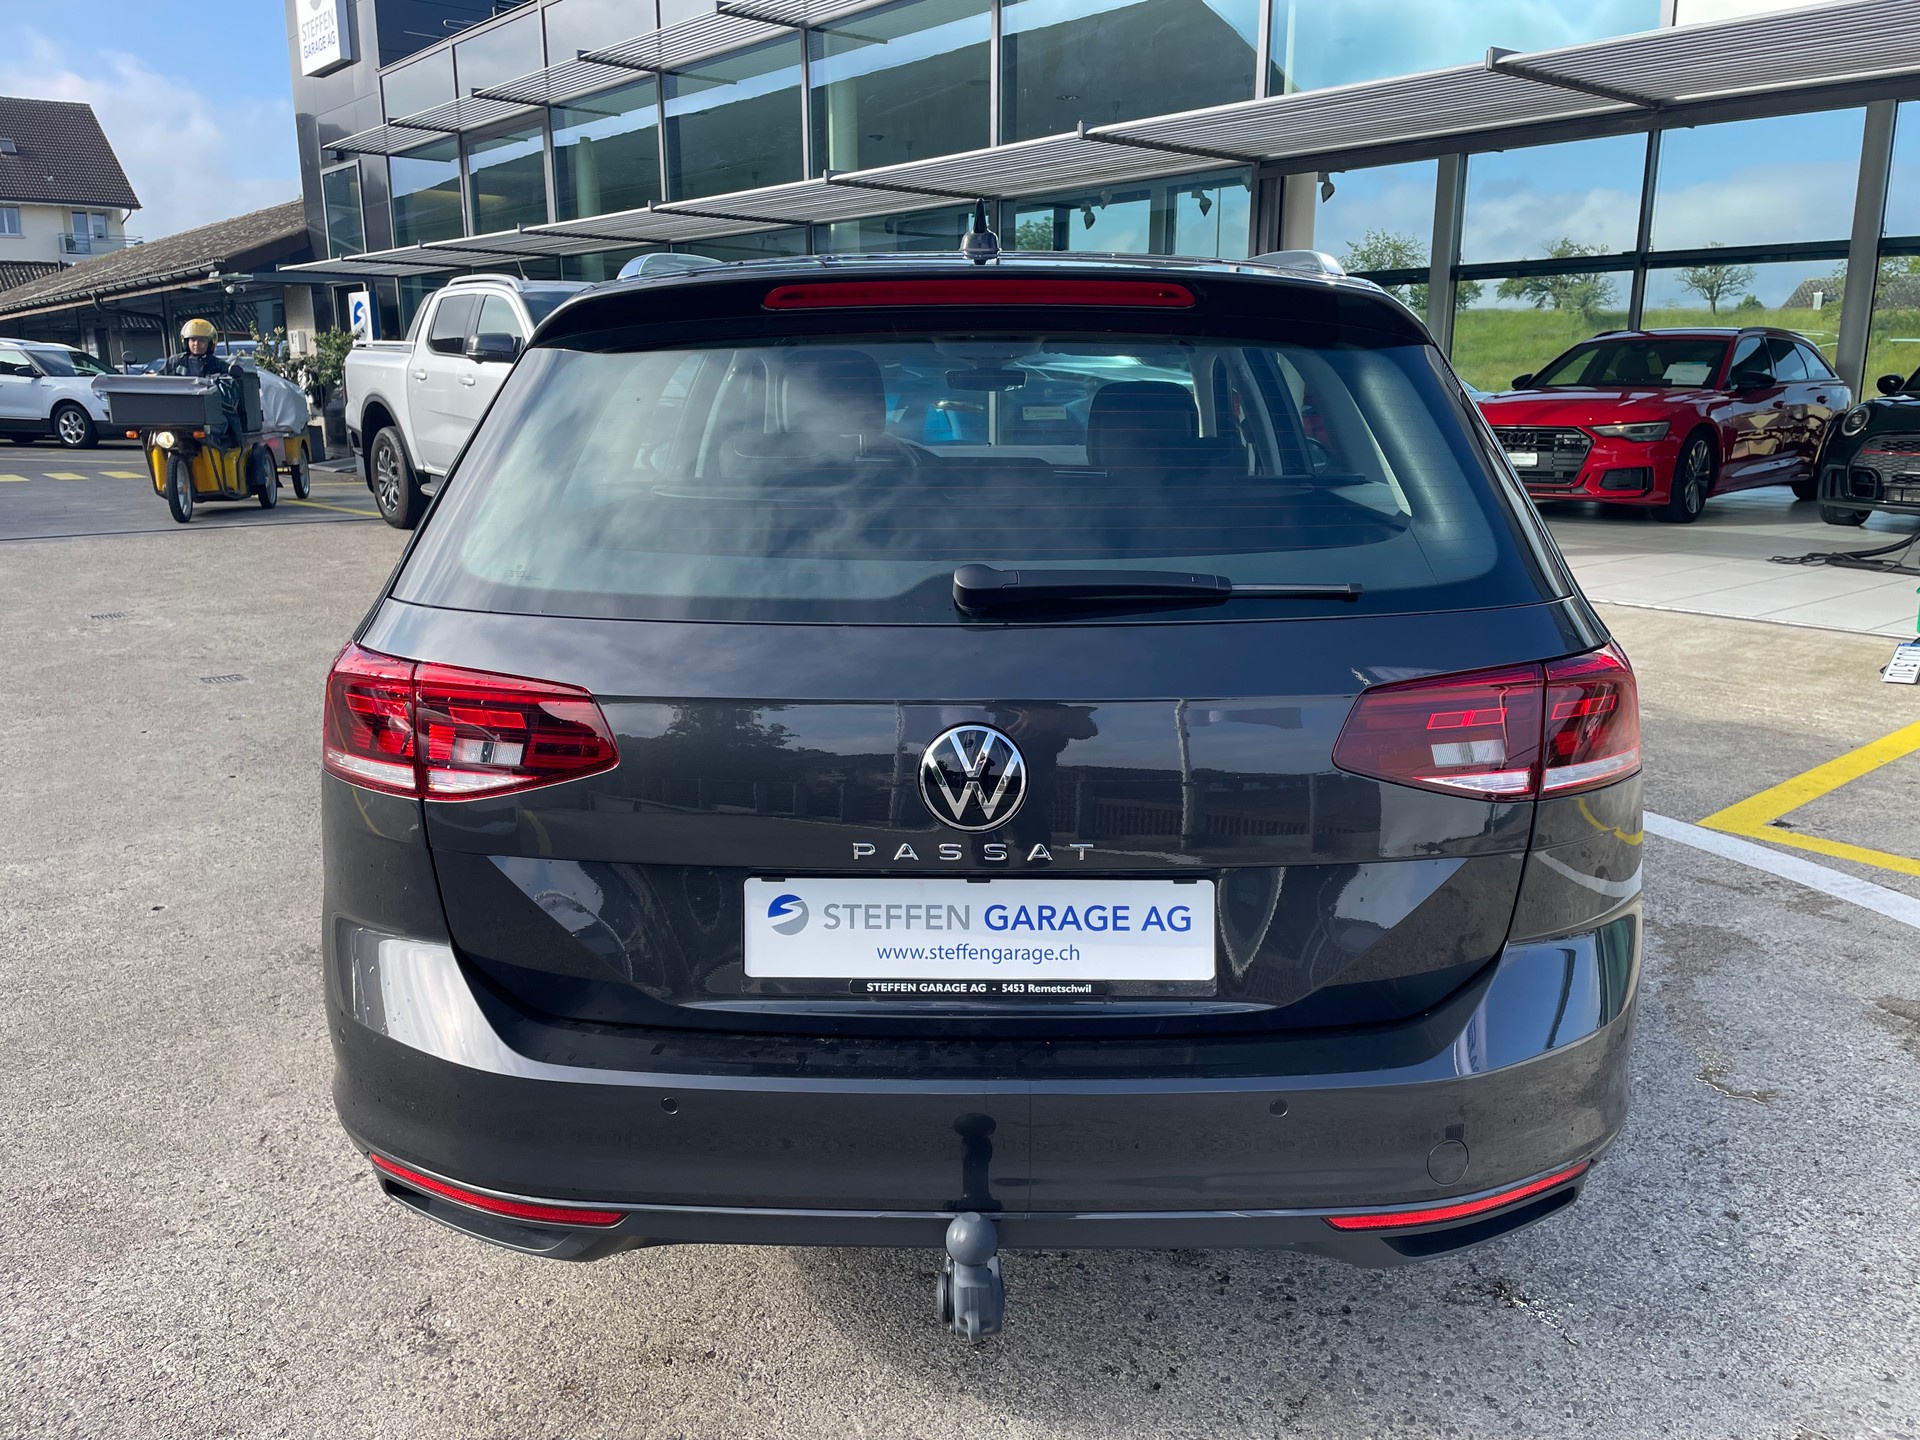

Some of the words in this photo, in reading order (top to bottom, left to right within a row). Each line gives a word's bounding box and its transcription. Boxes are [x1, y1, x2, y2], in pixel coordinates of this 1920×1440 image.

[302, 8, 334, 42] STEFFEN
[303, 35, 326, 58] GARAGE
[327, 30, 336, 47] AG
[852, 842, 1093, 861] PASSAT
[823, 903, 970, 931] STEFFEN
[984, 904, 1130, 932] GARAGE
[1141, 906, 1192, 932] AG
[876, 943, 1080, 964] www.steffengarage.ch
[866, 982, 917, 992] STEFFEN
[919, 983, 967, 993] GARAGE
[969, 983, 987, 993] AG
[1001, 984, 1025, 993] 5453
[1028, 983, 1092, 993] Remetschwil
